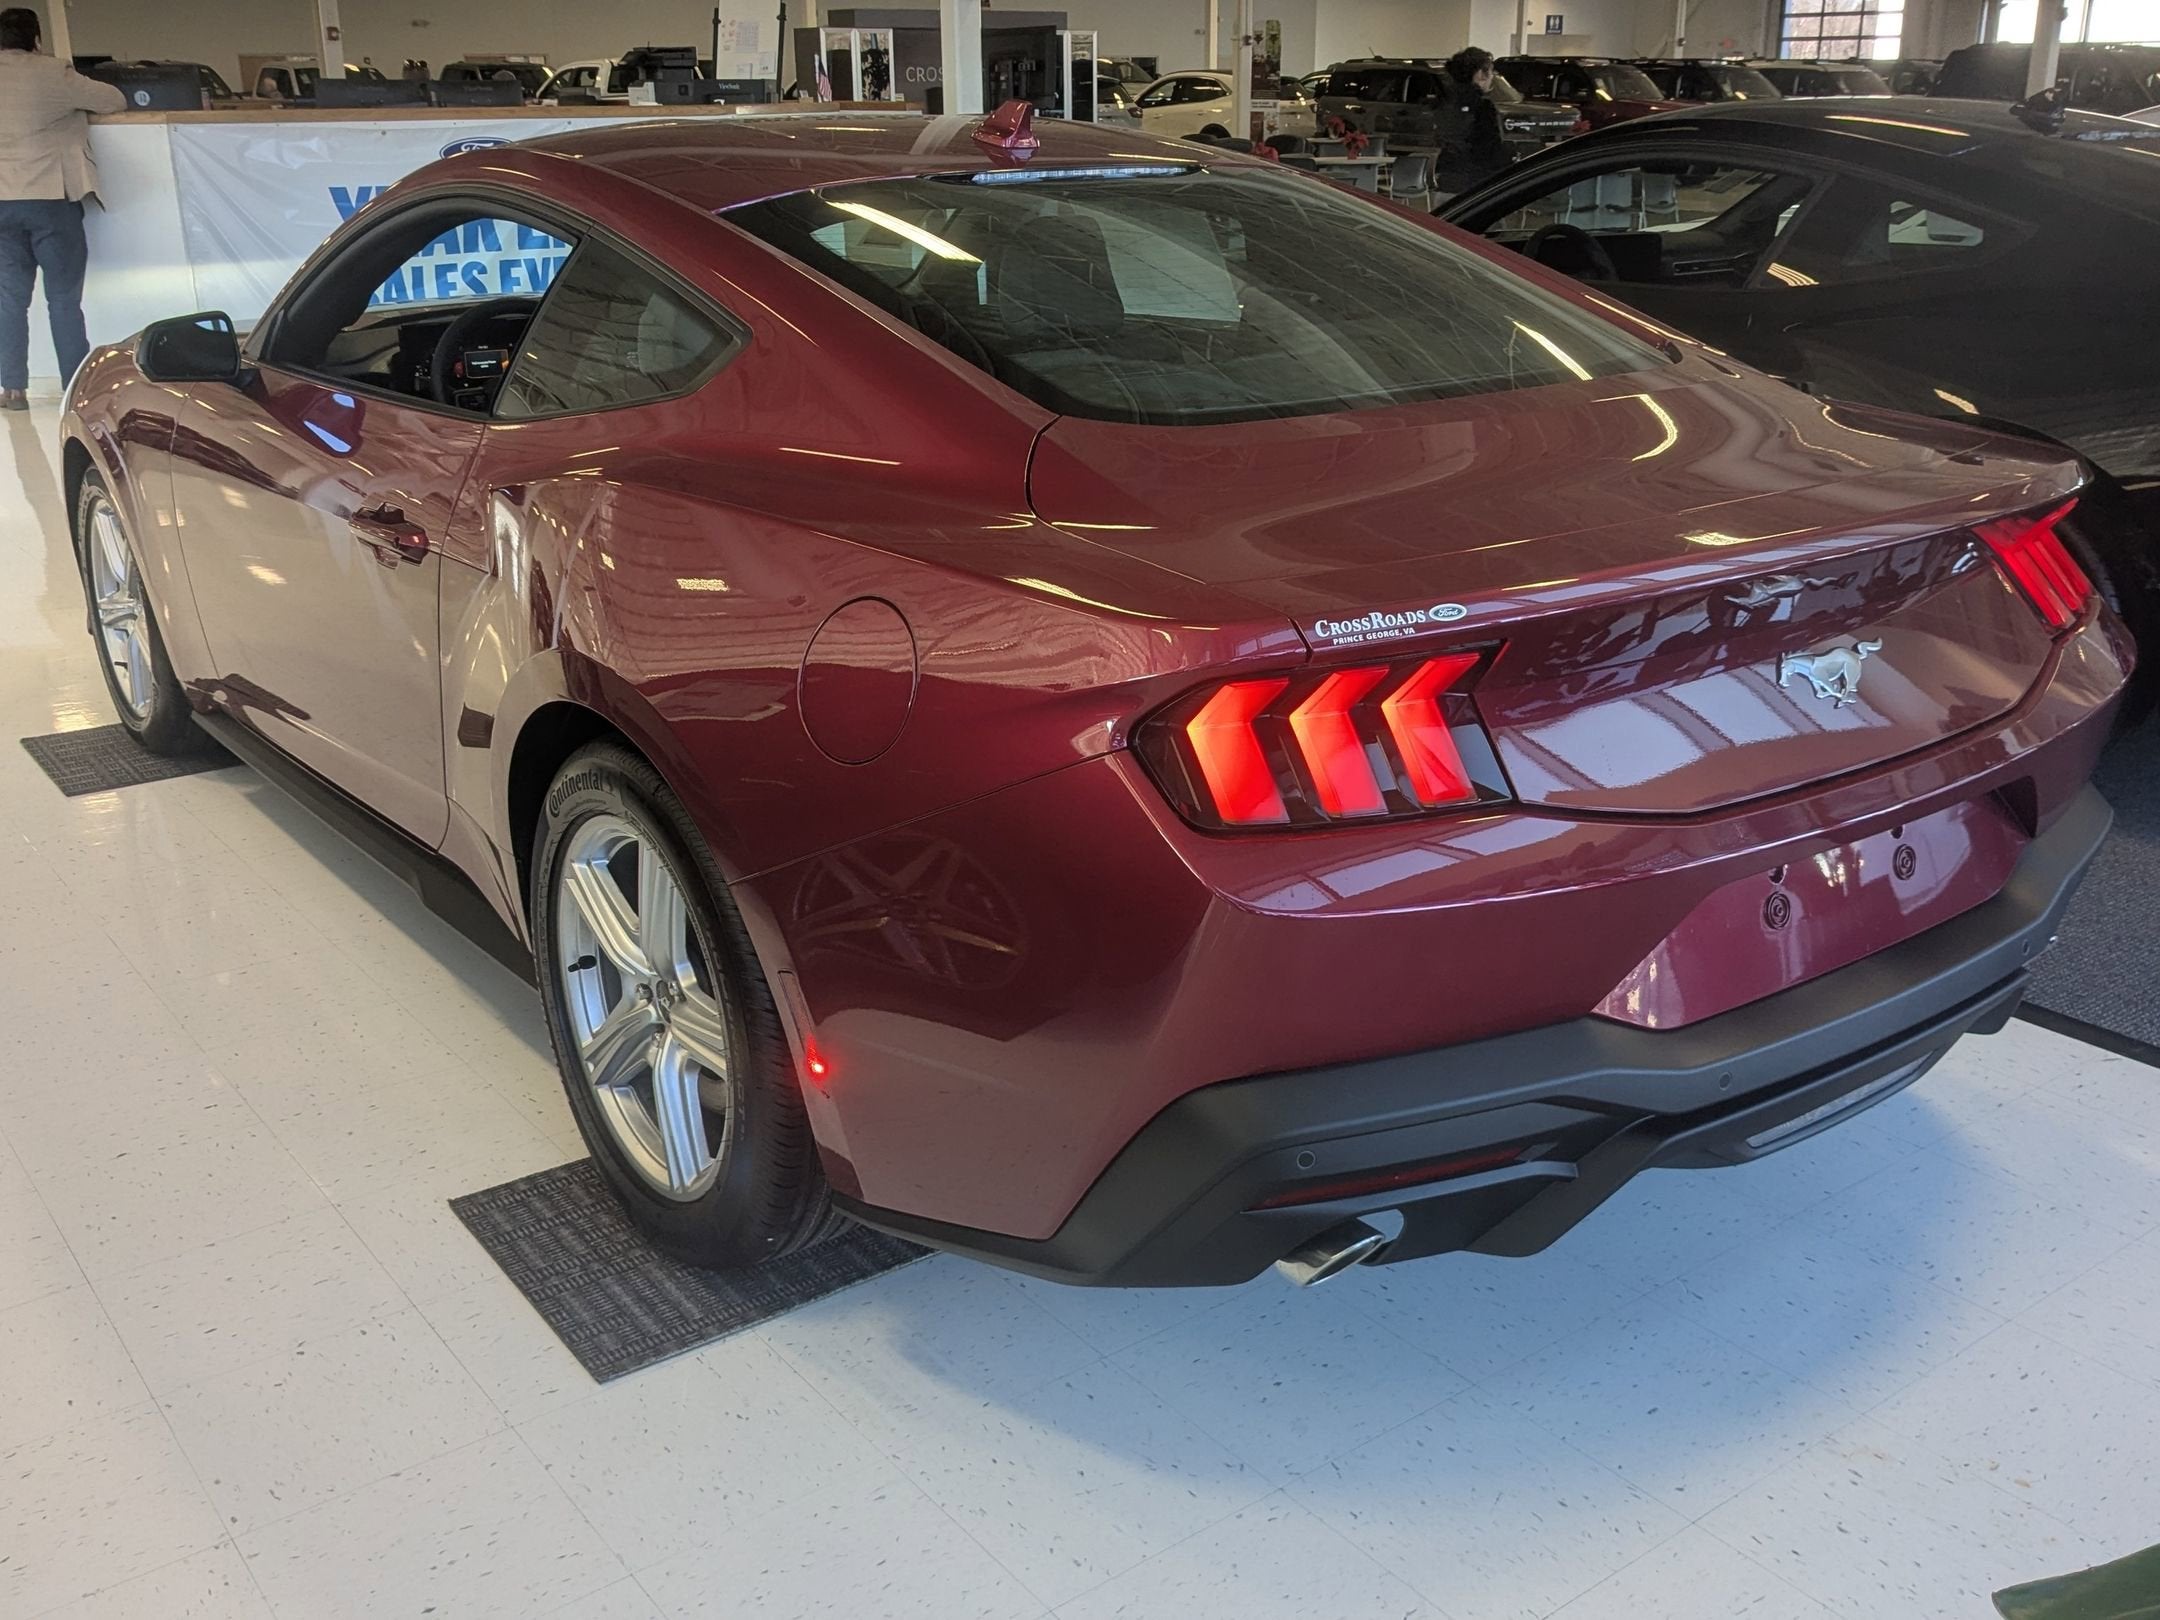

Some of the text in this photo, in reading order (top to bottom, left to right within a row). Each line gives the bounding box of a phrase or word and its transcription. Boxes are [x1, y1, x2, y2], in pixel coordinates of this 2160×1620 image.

[367, 261, 488, 305] ALES
[1332, 627, 1416, 645] PRINCE GEORGE, VA
[550, 768, 605, 818] Continental
